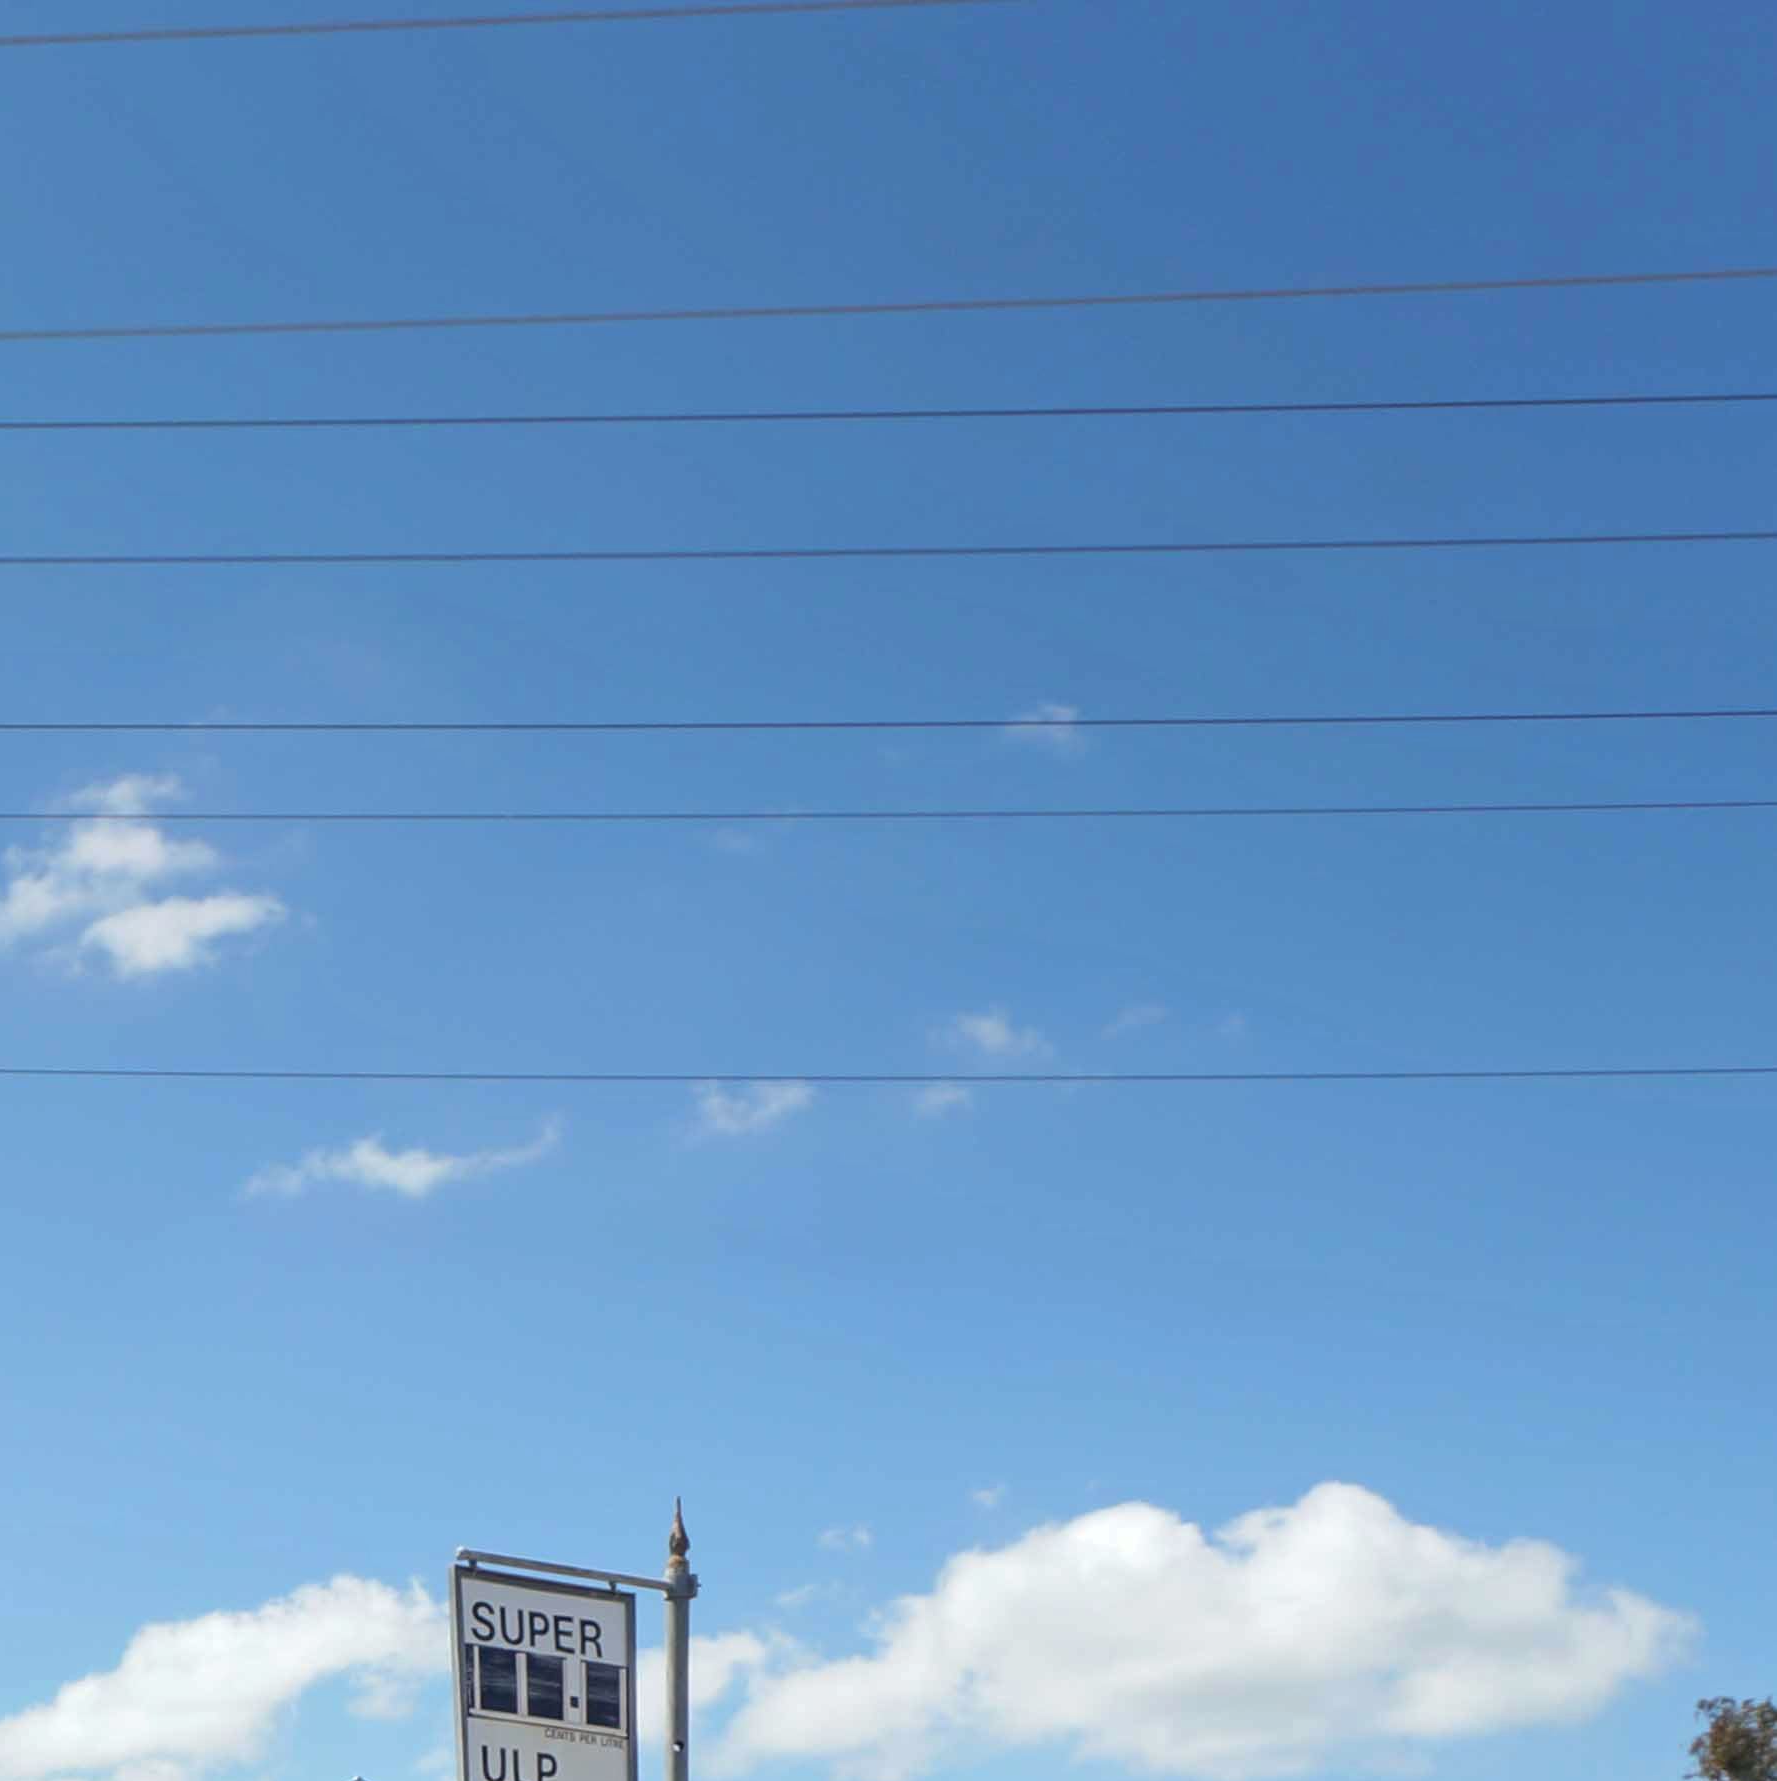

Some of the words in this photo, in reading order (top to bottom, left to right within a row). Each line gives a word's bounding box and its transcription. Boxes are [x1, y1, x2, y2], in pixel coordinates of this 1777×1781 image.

[470, 1600, 603, 1658] SUPER
[544, 1727, 576, 1743] CENTS
[579, 1733, 597, 1745] PER
[600, 1737, 625, 1748] LITRE
